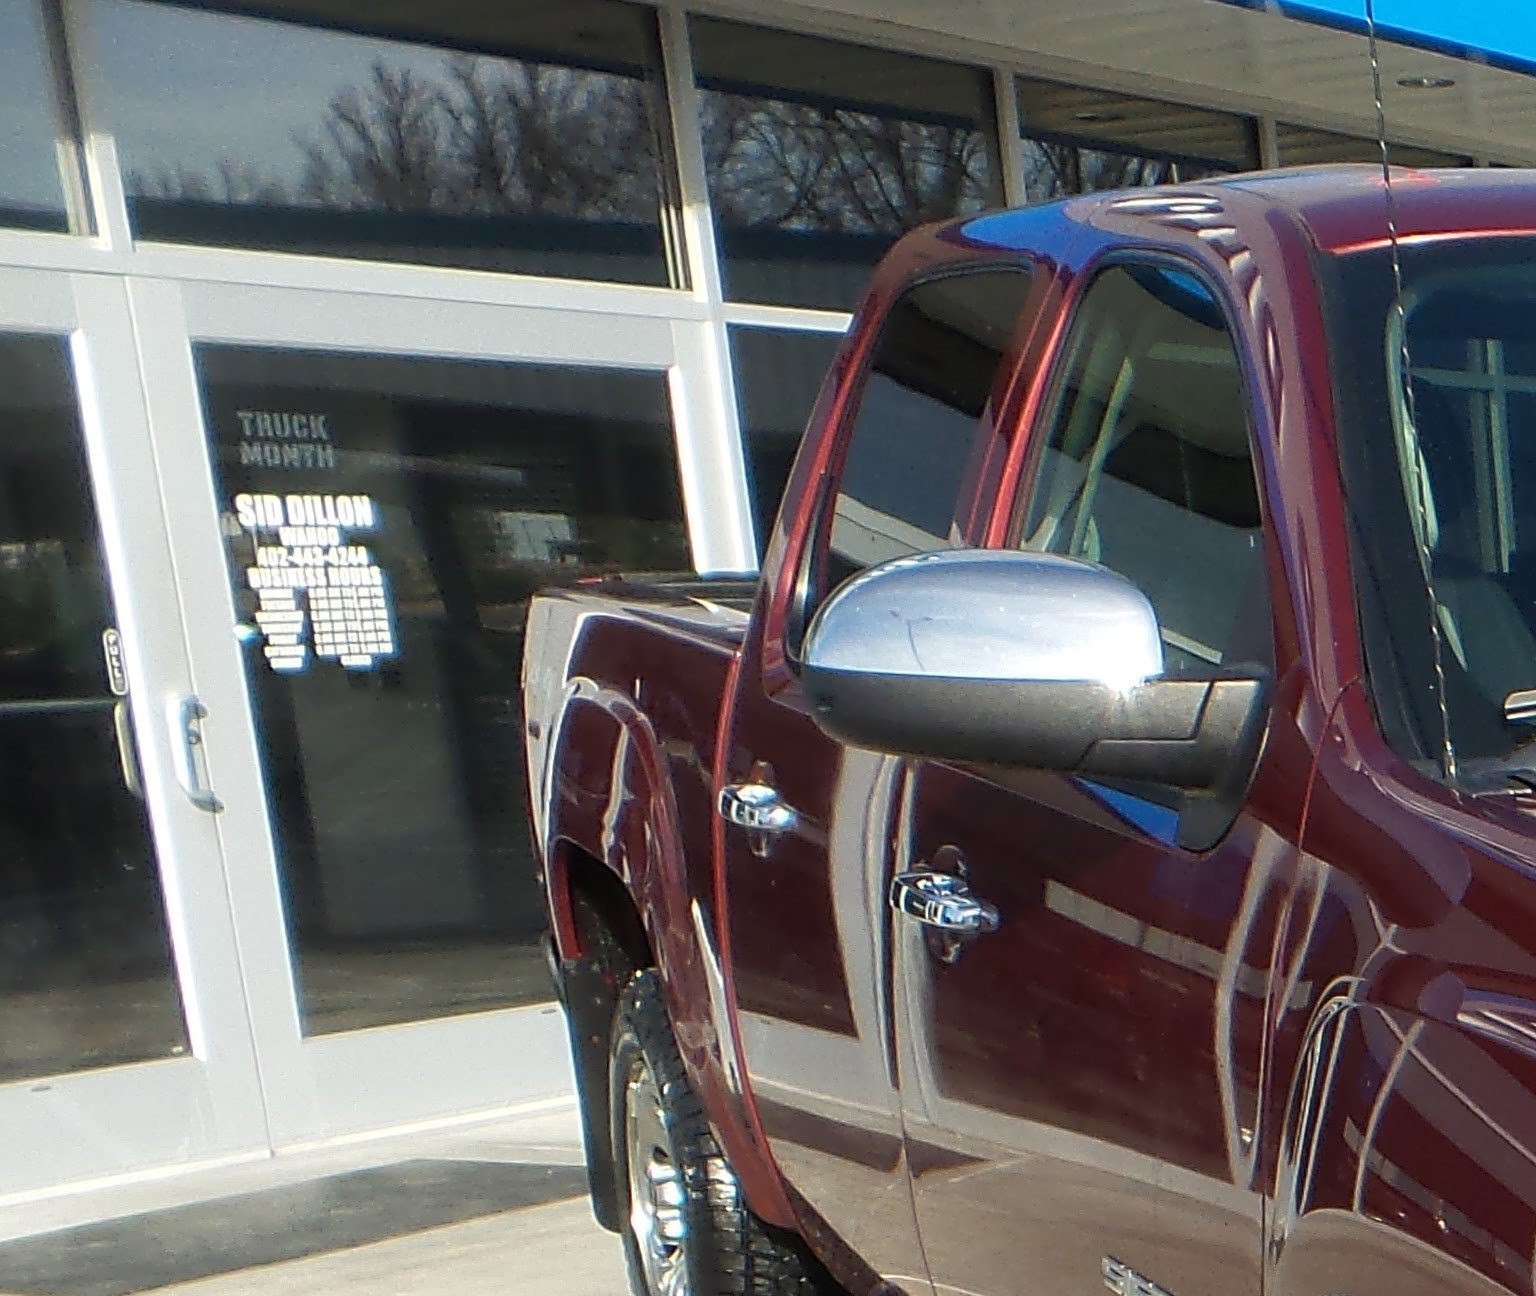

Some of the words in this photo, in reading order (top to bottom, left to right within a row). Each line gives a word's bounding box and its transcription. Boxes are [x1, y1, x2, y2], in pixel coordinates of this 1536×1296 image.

[237, 411, 328, 440] TRUCK
[239, 441, 335, 468] MONTH
[235, 493, 284, 527] SID
[285, 494, 374, 526] DILLON
